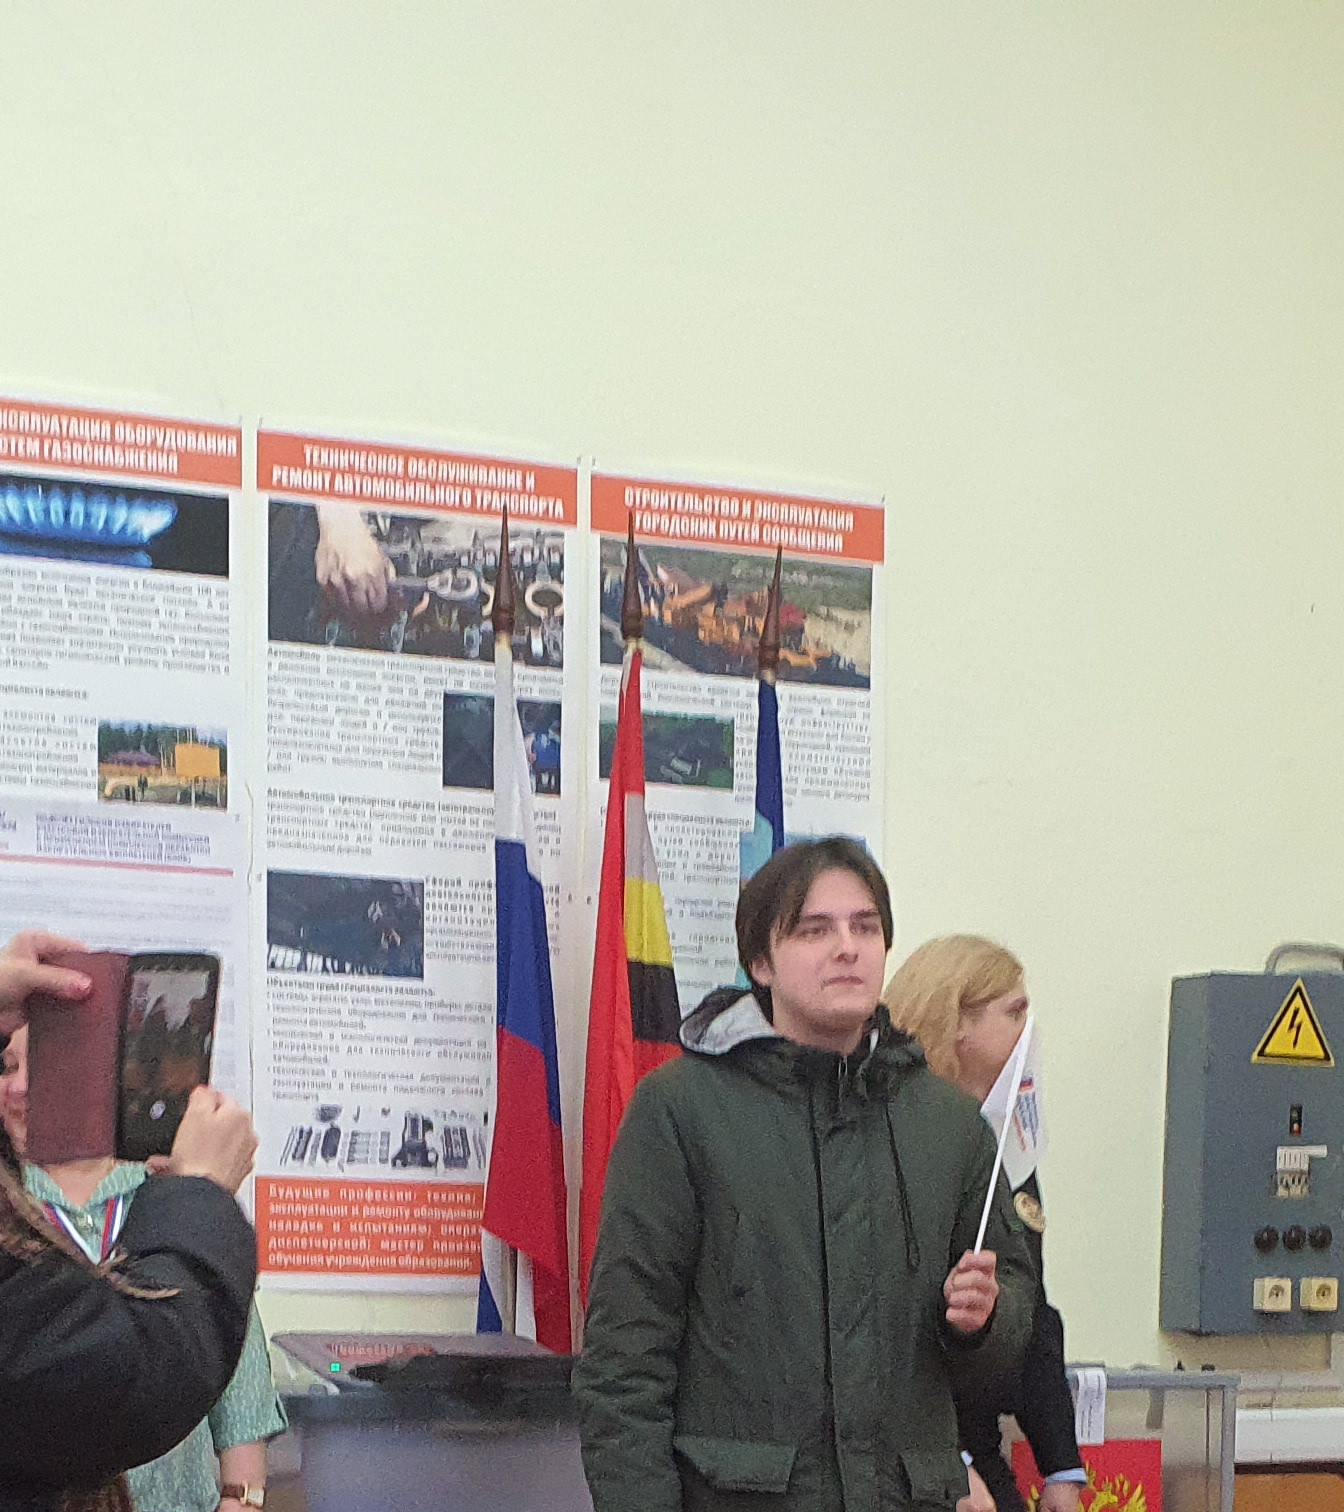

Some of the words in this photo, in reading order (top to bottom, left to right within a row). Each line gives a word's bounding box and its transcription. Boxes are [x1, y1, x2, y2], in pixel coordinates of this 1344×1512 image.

[43, 437, 179, 474] ГАЗОСНАБЖЕНИЯ
[114, 420, 237, 457] ОБОРУДОВАНИЯ
[304, 444, 405, 476] ТЕХНИЧЕСКОЕ
[408, 456, 522, 491] ОБСЛУЖИВАНИЕ
[525, 471, 535, 493] И
[272, 464, 332, 493] РЕМОНТ
[334, 472, 472, 508] АВТОМОБИЛЬНОГО
[475, 490, 564, 520] ТРАНСПОРТА
[624, 486, 739, 518] СТРОИТЕЛЬСТВО
[742, 498, 752, 520] И
[754, 500, 853, 532] ЭКСПЛУАТАЦИЯ
[634, 510, 716, 538] ГОРОДСКИХ
[719, 519, 760, 543] ПУТЕЙ
[762, 523, 843, 553] СООБЩЕНИЯ
[269, 1183, 329, 1202] Будущие
